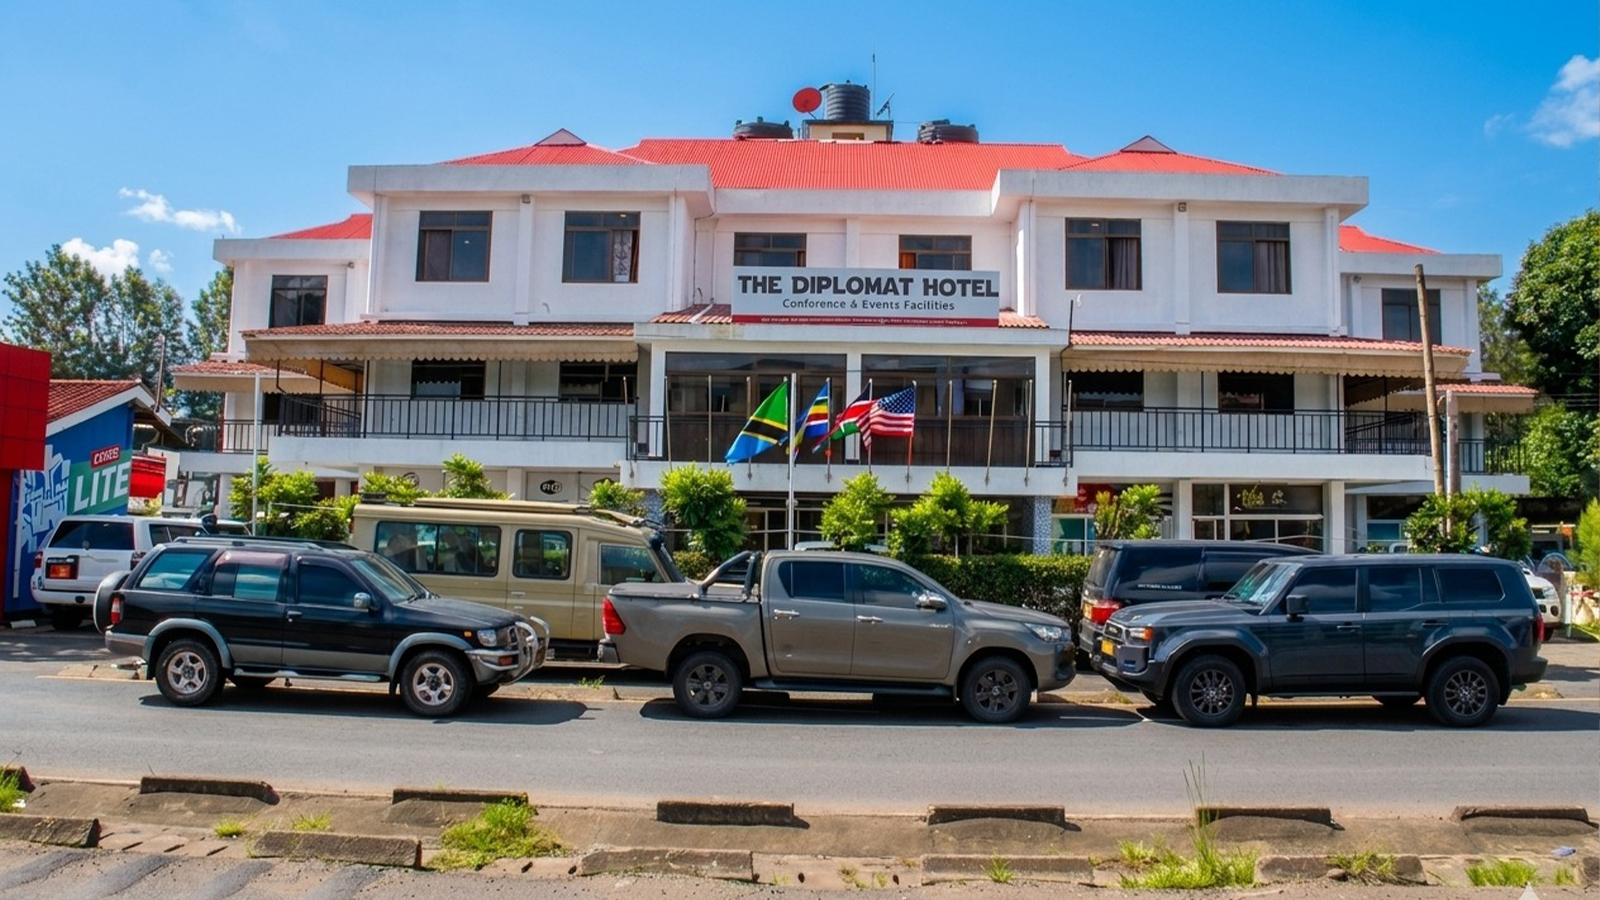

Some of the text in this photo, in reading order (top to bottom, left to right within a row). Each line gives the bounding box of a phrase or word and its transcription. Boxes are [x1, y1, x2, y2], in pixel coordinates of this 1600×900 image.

[738, 275, 999, 297] THE DIPLOMAT HOTEL
[850, 299, 858, 309] &
[862, 300, 900, 310] Events
[904, 301, 955, 311] Facilities
[73, 461, 130, 513] LITE
